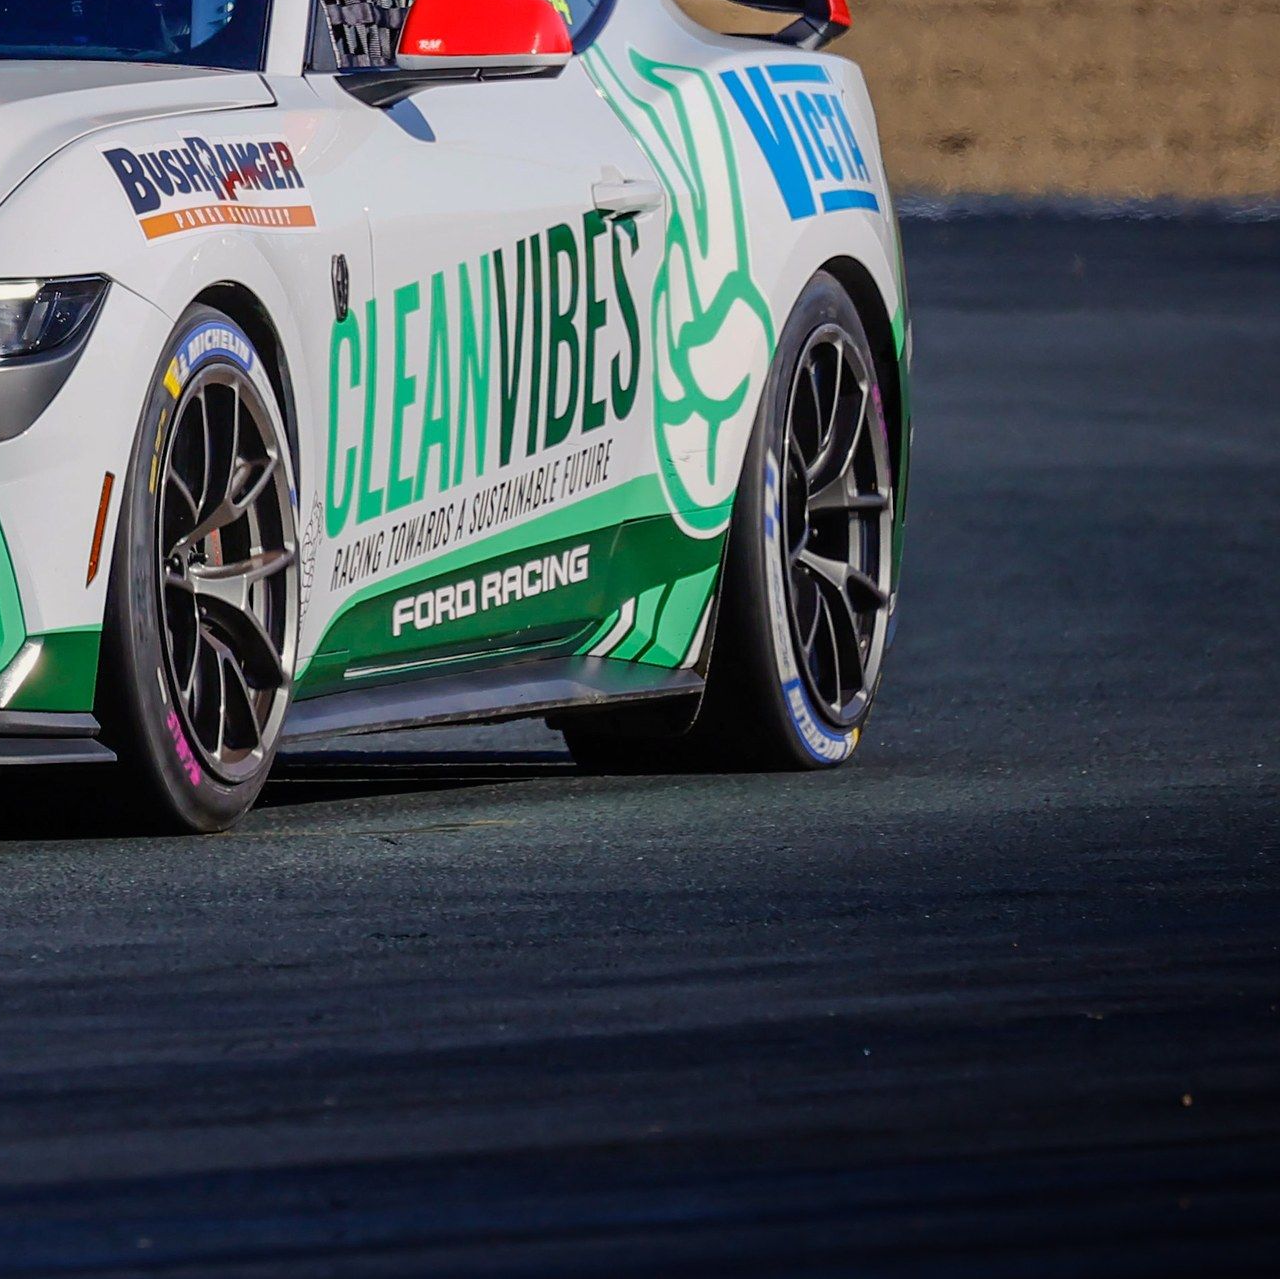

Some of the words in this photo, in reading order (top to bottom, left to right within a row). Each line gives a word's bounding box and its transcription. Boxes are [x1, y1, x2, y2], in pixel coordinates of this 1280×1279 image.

[719, 64, 871, 221] VICTA
[175, 207, 224, 228] POWER
[188, 328, 250, 365] MICHELIN
[330, 531, 385, 592] RACING
[387, 503, 455, 569] TOWARDS
[454, 498, 468, 541] A
[469, 461, 560, 534] SUSTAINABLE
[560, 439, 614, 500] FUTURE
[393, 580, 477, 637] FORD
[482, 545, 590, 611] RACING
